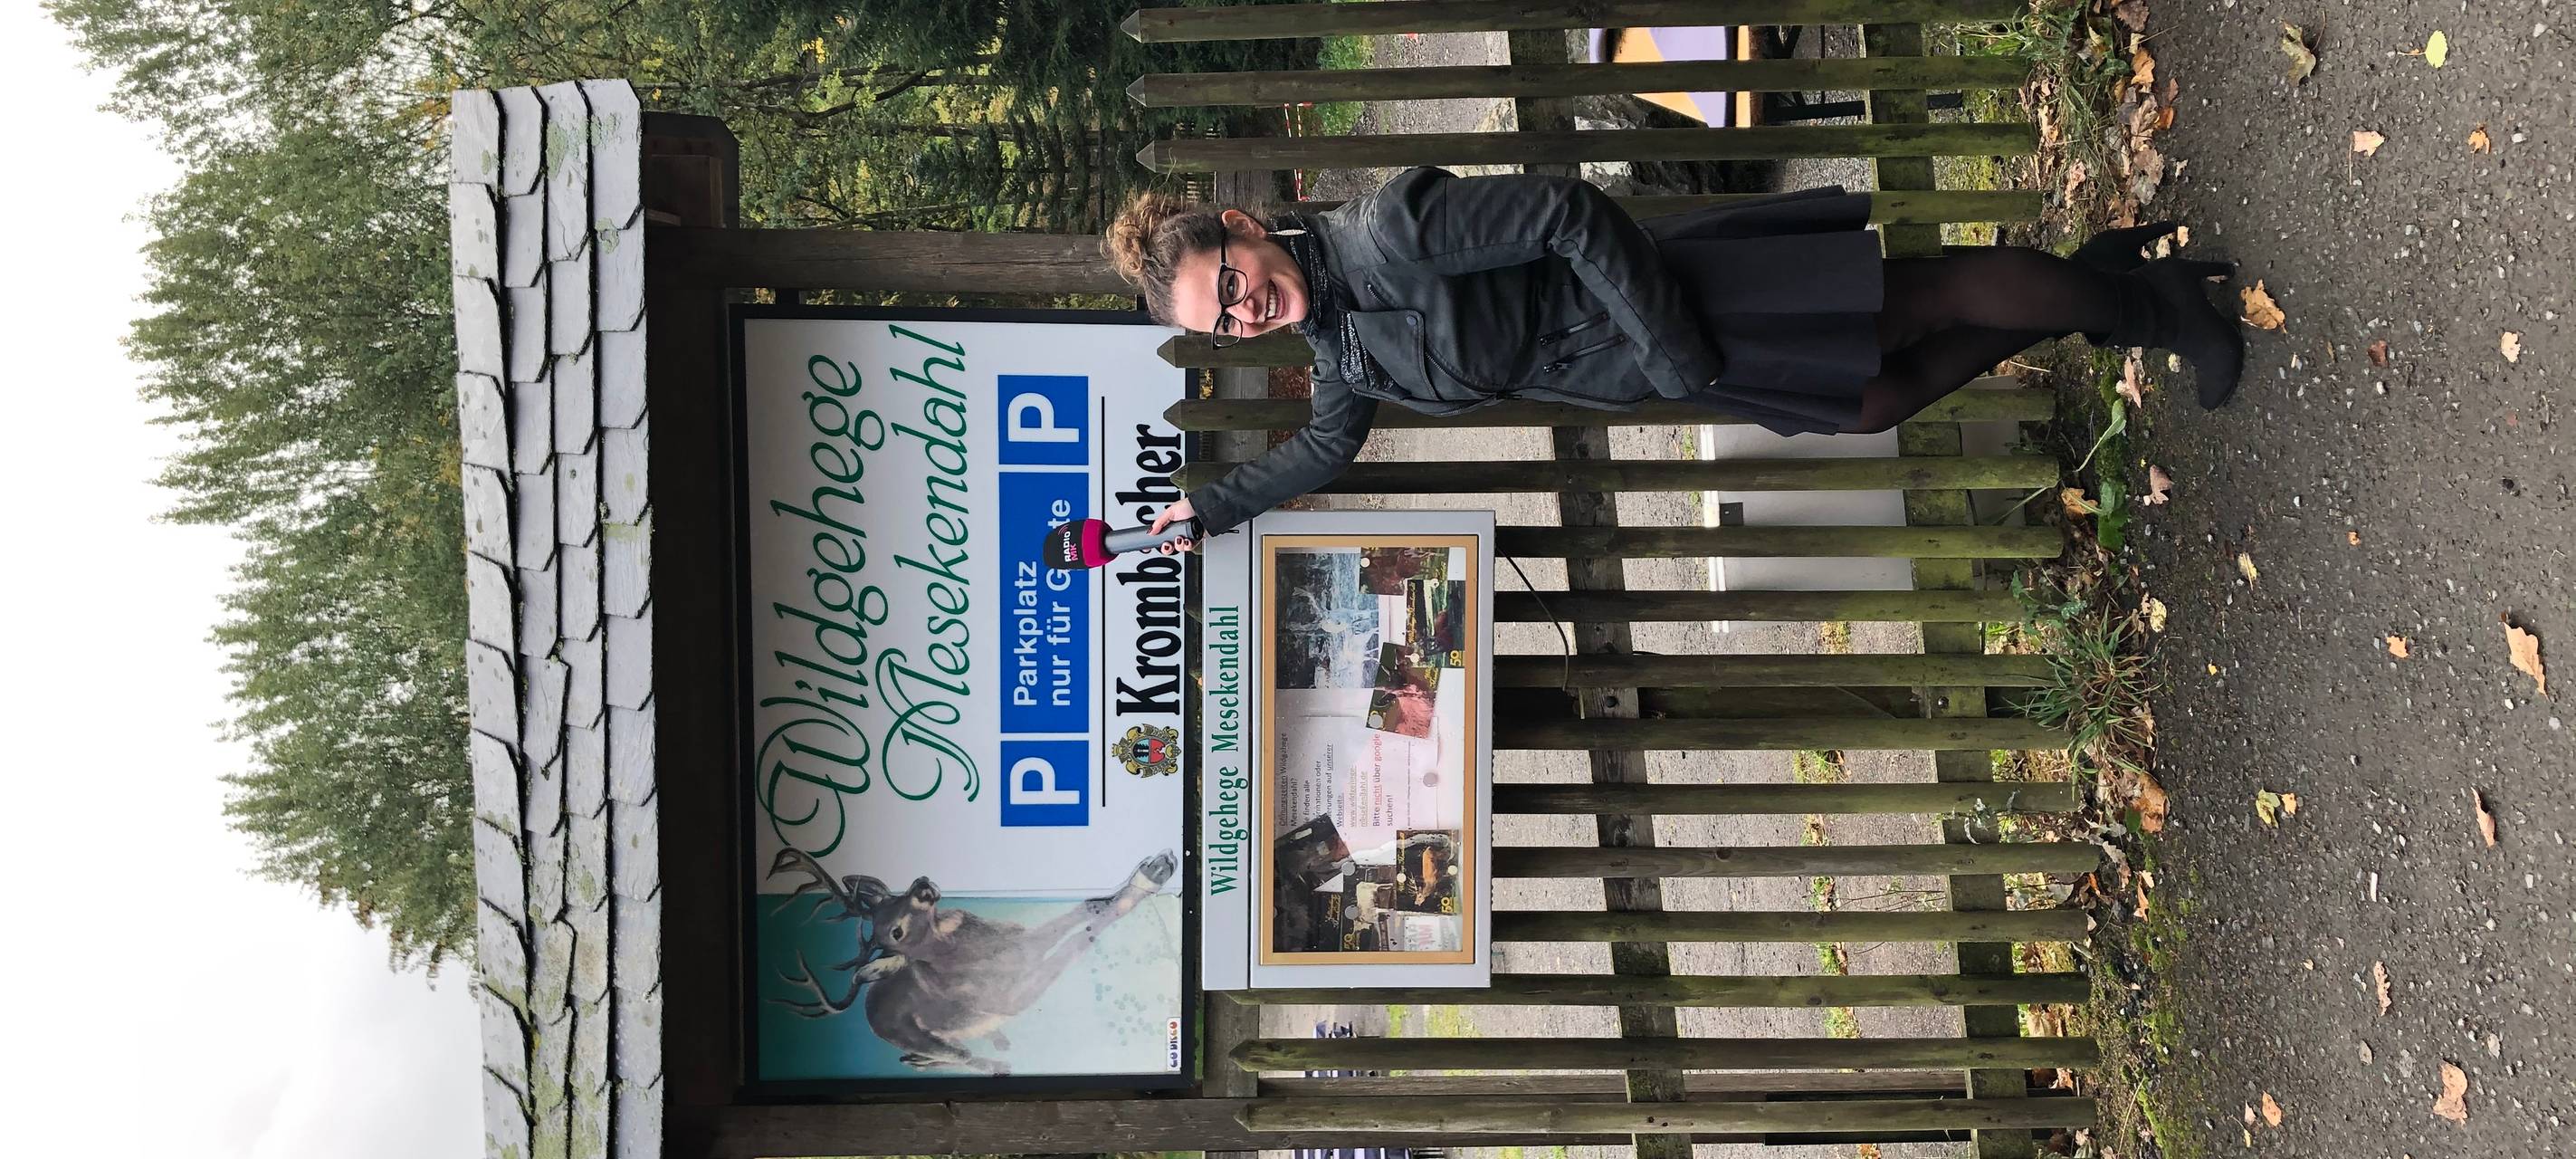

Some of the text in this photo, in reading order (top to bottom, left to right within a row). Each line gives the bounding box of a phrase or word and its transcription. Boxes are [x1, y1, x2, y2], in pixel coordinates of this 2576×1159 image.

[1007, 392, 1080, 443] P
[875, 324, 979, 802] Mesekendahl
[1063, 531, 1072, 562] RADIO
[1070, 543, 1079, 561] MK
[1114, 424, 1181, 717] Krombcher
[755, 354, 888, 858] Wildgehege
[1046, 499, 1072, 706] nur für Gte
[1013, 560, 1044, 706] Parkplatz
[1450, 650, 1462, 666] 50
[1208, 605, 1248, 896] Wildgehege Mesekendahl
[1372, 733, 1381, 761] google
[1009, 757, 1080, 805] P
[1372, 784, 1381, 805] nicht
[1441, 896, 1454, 913] 50
